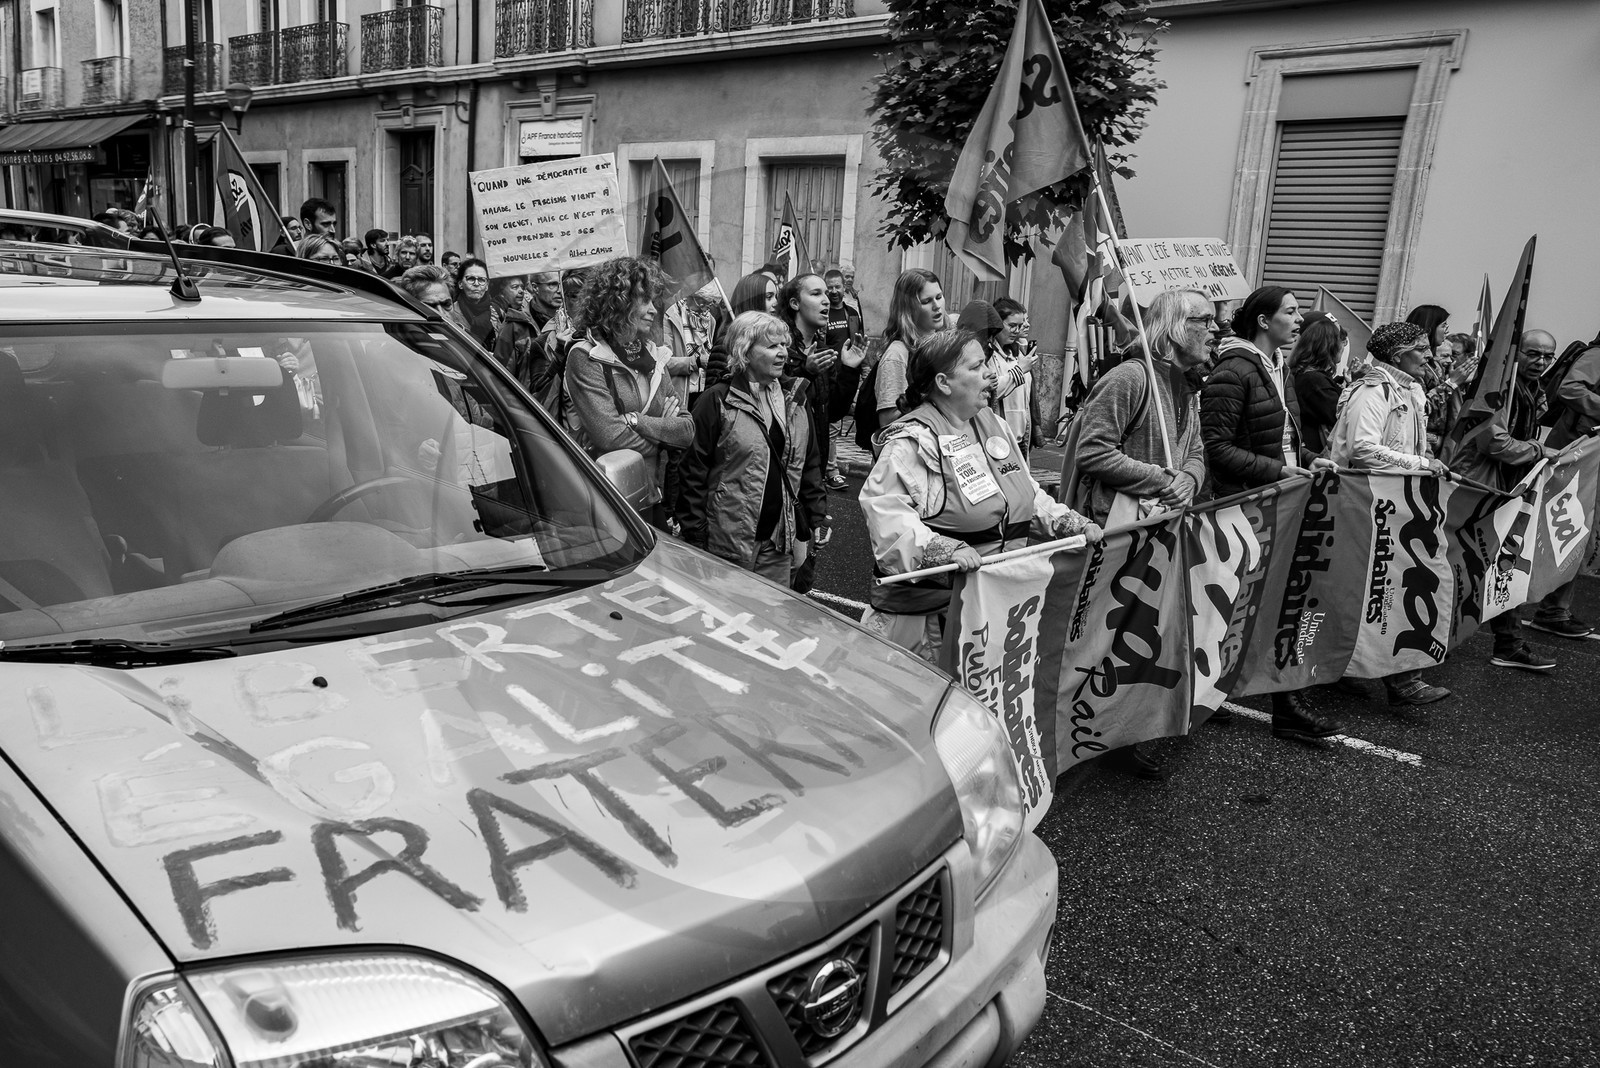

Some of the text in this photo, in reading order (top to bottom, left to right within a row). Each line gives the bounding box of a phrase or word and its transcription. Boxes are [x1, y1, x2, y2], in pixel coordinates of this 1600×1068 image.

[526, 131, 583, 140] APF France handicap
[0, 155, 21, 164] isines
[23, 155, 31, 163] et
[33, 153, 53, 163] bains
[516, 177, 532, 186] UNE
[516, 202, 526, 210] LE
[571, 191, 596, 202] VIENT
[485, 223, 499, 231] SON
[537, 215, 556, 224] MAIS
[559, 213, 569, 221] CE
[573, 210, 595, 220] N'EST
[601, 207, 615, 216] PAS
[487, 238, 507, 247] POUR
[516, 232, 554, 243] PRENDRE
[1120, 244, 1146, 267] VANT
[1173, 243, 1204, 258] AUCUNE
[1204, 241, 1232, 257] ENVIE
[1129, 273, 1141, 286] E
[1141, 270, 1156, 285] SE
[1159, 267, 1192, 281] METTRE
[1193, 265, 1208, 278] AU
[959, 467, 977, 479] TOUS
[1274, 471, 1341, 670] Solidaires
[1366, 498, 1396, 625] Solidaires
[1219, 500, 1275, 678] olidaires
[1296, 611, 1312, 665] syndicale
[1304, 611, 1326, 646] Union
[1429, 641, 1443, 660] PTT
[1003, 595, 1042, 808] Solidaires
[1070, 656, 1118, 759] Rail
